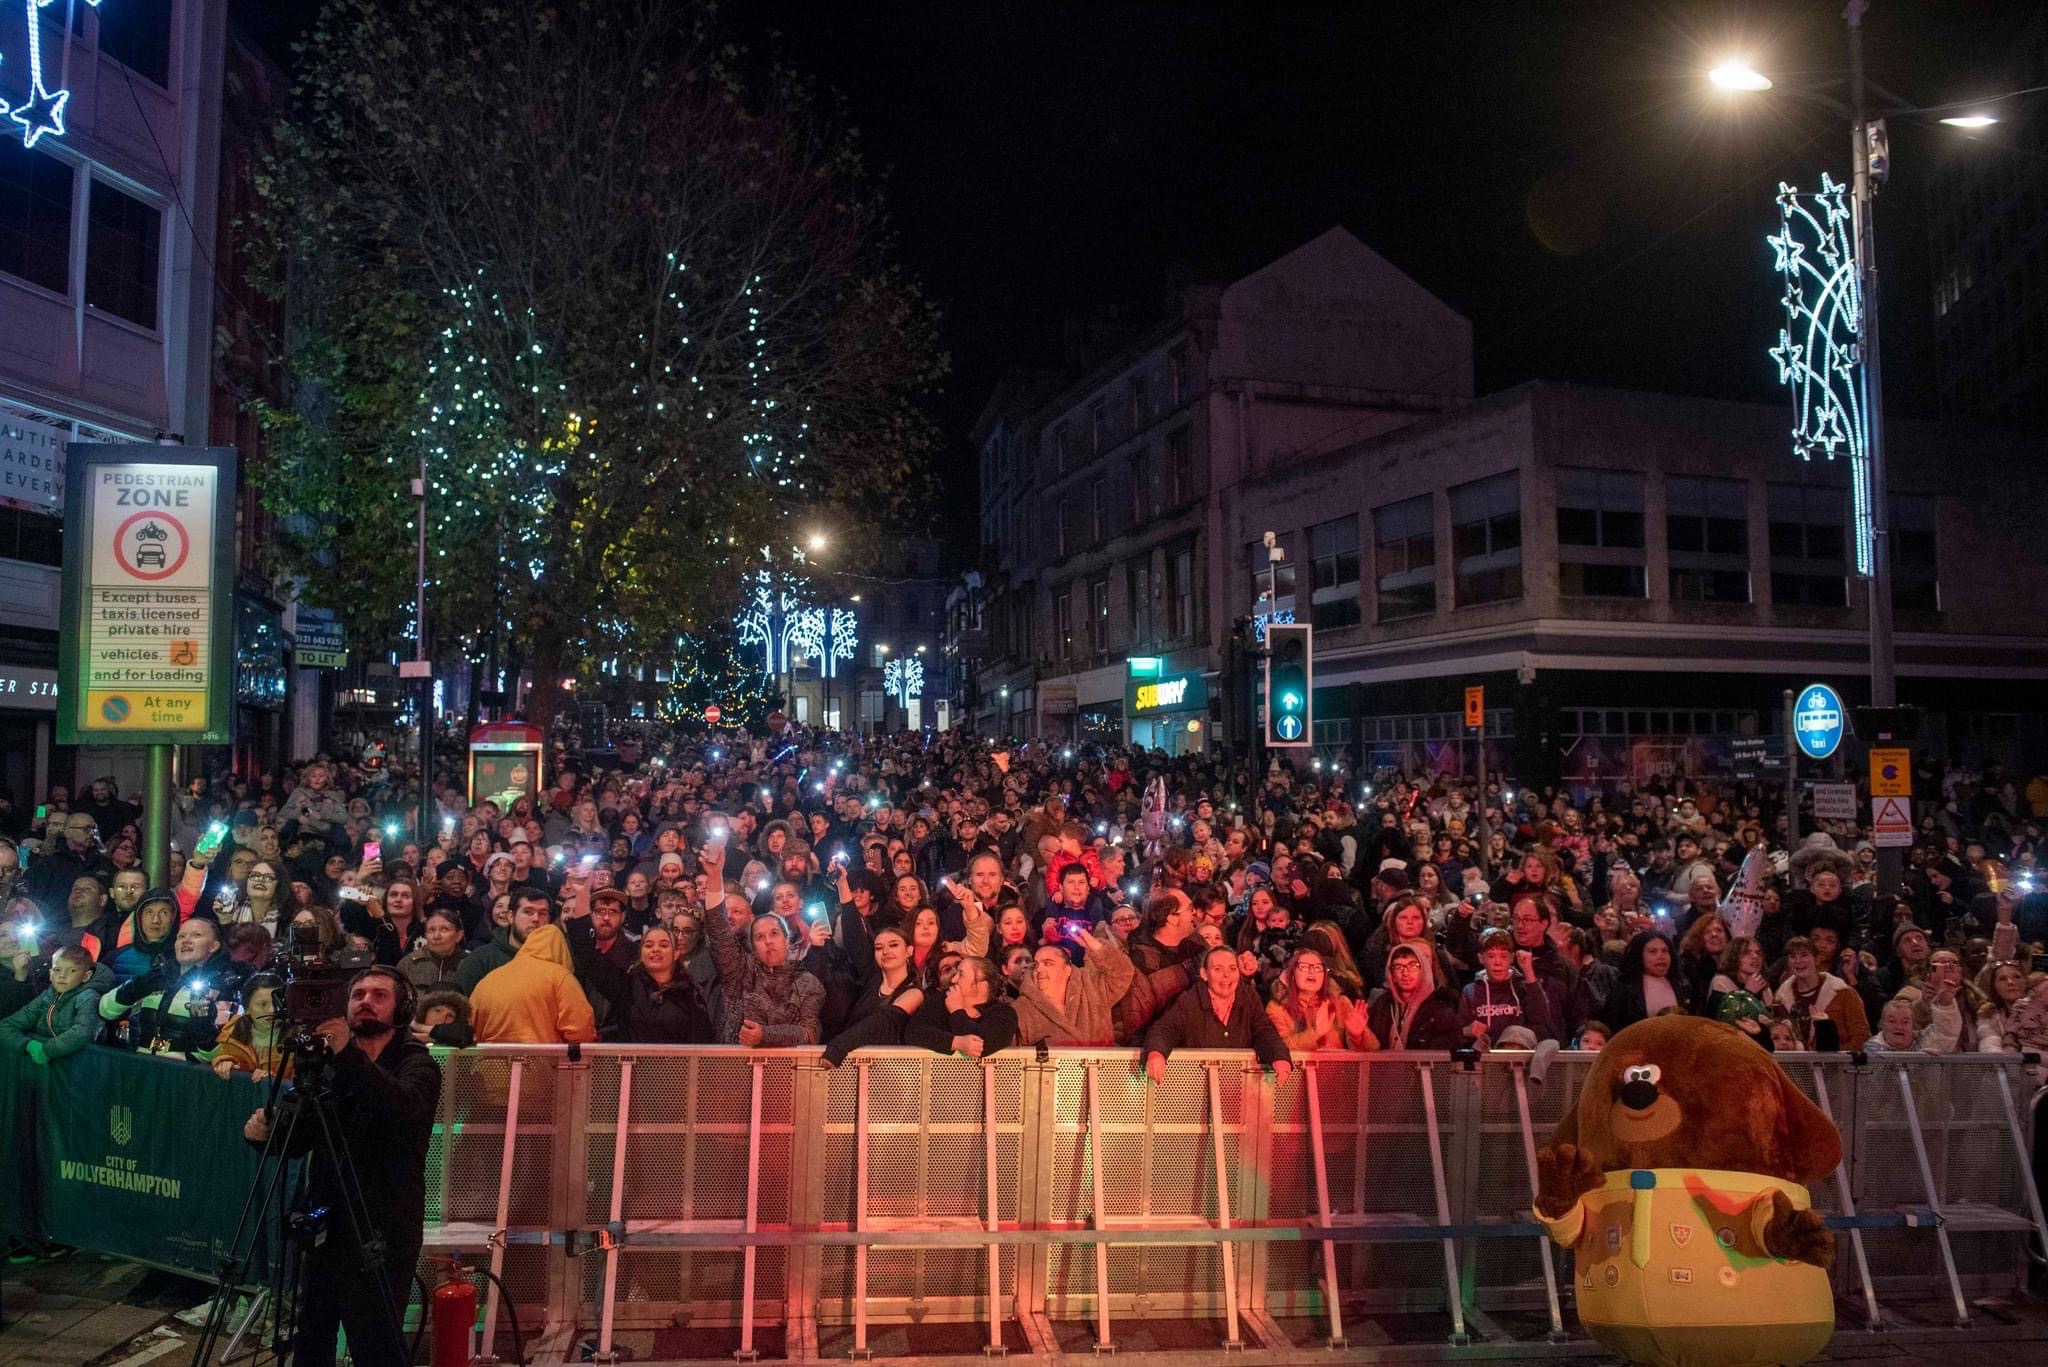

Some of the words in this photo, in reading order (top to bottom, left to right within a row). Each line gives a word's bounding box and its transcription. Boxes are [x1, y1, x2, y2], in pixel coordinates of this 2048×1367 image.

[5, 471, 64, 497] EVERY
[103, 473, 205, 486] PEDESTRIAN
[116, 488, 189, 507] ZONE
[101, 591, 151, 605] Except
[142, 608, 200, 620] licensed
[108, 624, 160, 637] private
[163, 624, 191, 635] hire
[300, 652, 315, 663] TO
[318, 653, 337, 664] LET
[94, 669, 121, 680] and
[125, 669, 146, 680] for
[150, 669, 203, 683] loading
[1136, 677, 1188, 711] SUBWAY
[144, 696, 161, 708] At
[166, 698, 191, 710] any
[151, 711, 184, 722] time
[1811, 738, 1826, 748] taxi
[106, 1155, 125, 1169] CITY
[127, 1159, 138, 1171] OF
[61, 1160, 181, 1199] WOLVERHAMPTON
